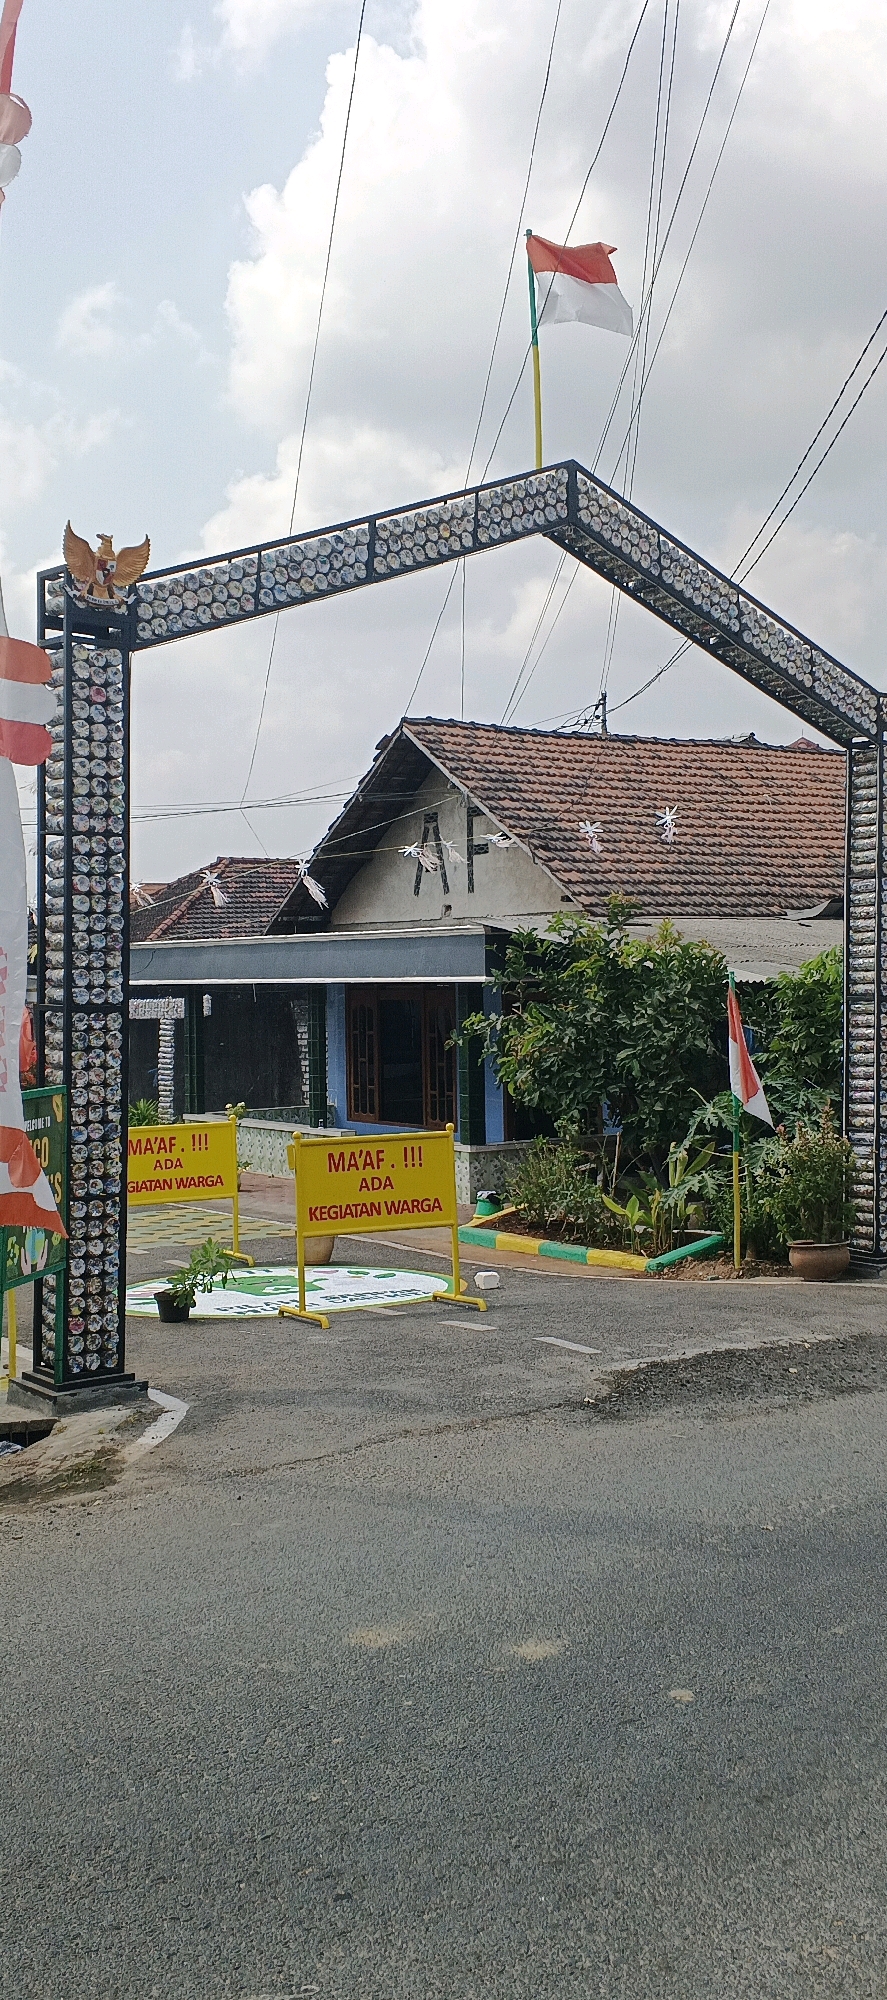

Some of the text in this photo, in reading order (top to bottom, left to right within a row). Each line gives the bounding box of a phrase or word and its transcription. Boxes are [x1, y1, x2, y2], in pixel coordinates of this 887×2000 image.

[30, 1136, 49, 1168] CO
[127, 1136, 177, 1156] MA'AF
[191, 1133, 209, 1152] !!!
[153, 1157, 184, 1172] ADA
[327, 1149, 385, 1173] MA'AF
[403, 1145, 423, 1169] !!!
[127, 1174, 225, 1194] GIATAN WARGA
[358, 1175, 395, 1192] ADA
[308, 1197, 443, 1222] KEGIATAN WARGA
